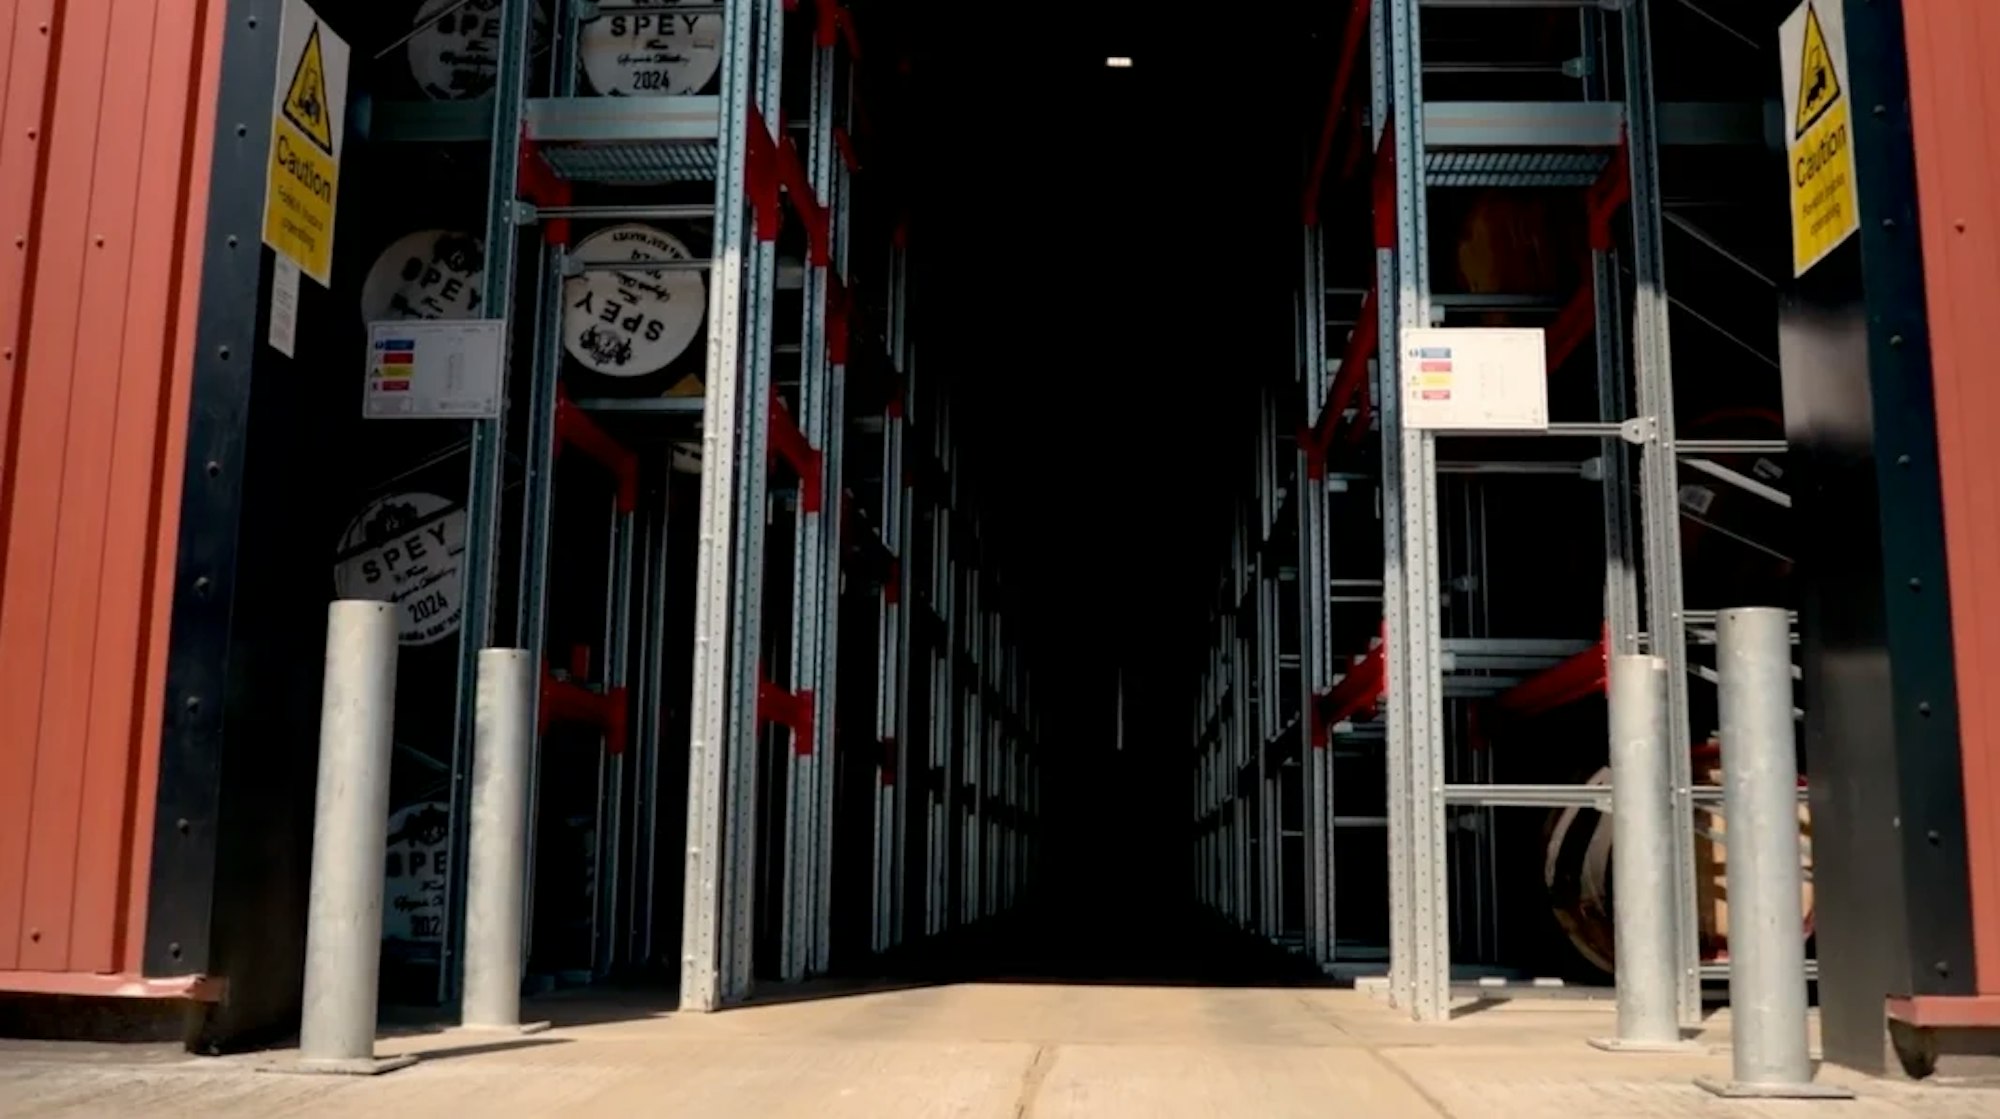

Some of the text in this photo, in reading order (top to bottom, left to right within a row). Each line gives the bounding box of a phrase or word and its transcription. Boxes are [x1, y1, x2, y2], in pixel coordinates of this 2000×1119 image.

[611, 14, 699, 36] SPEY
[632, 70, 670, 90] 2024
[277, 135, 331, 204] Caution
[1795, 123, 1847, 188] Caution
[574, 290, 665, 341] SPEY
[362, 522, 446, 584] SPEY
